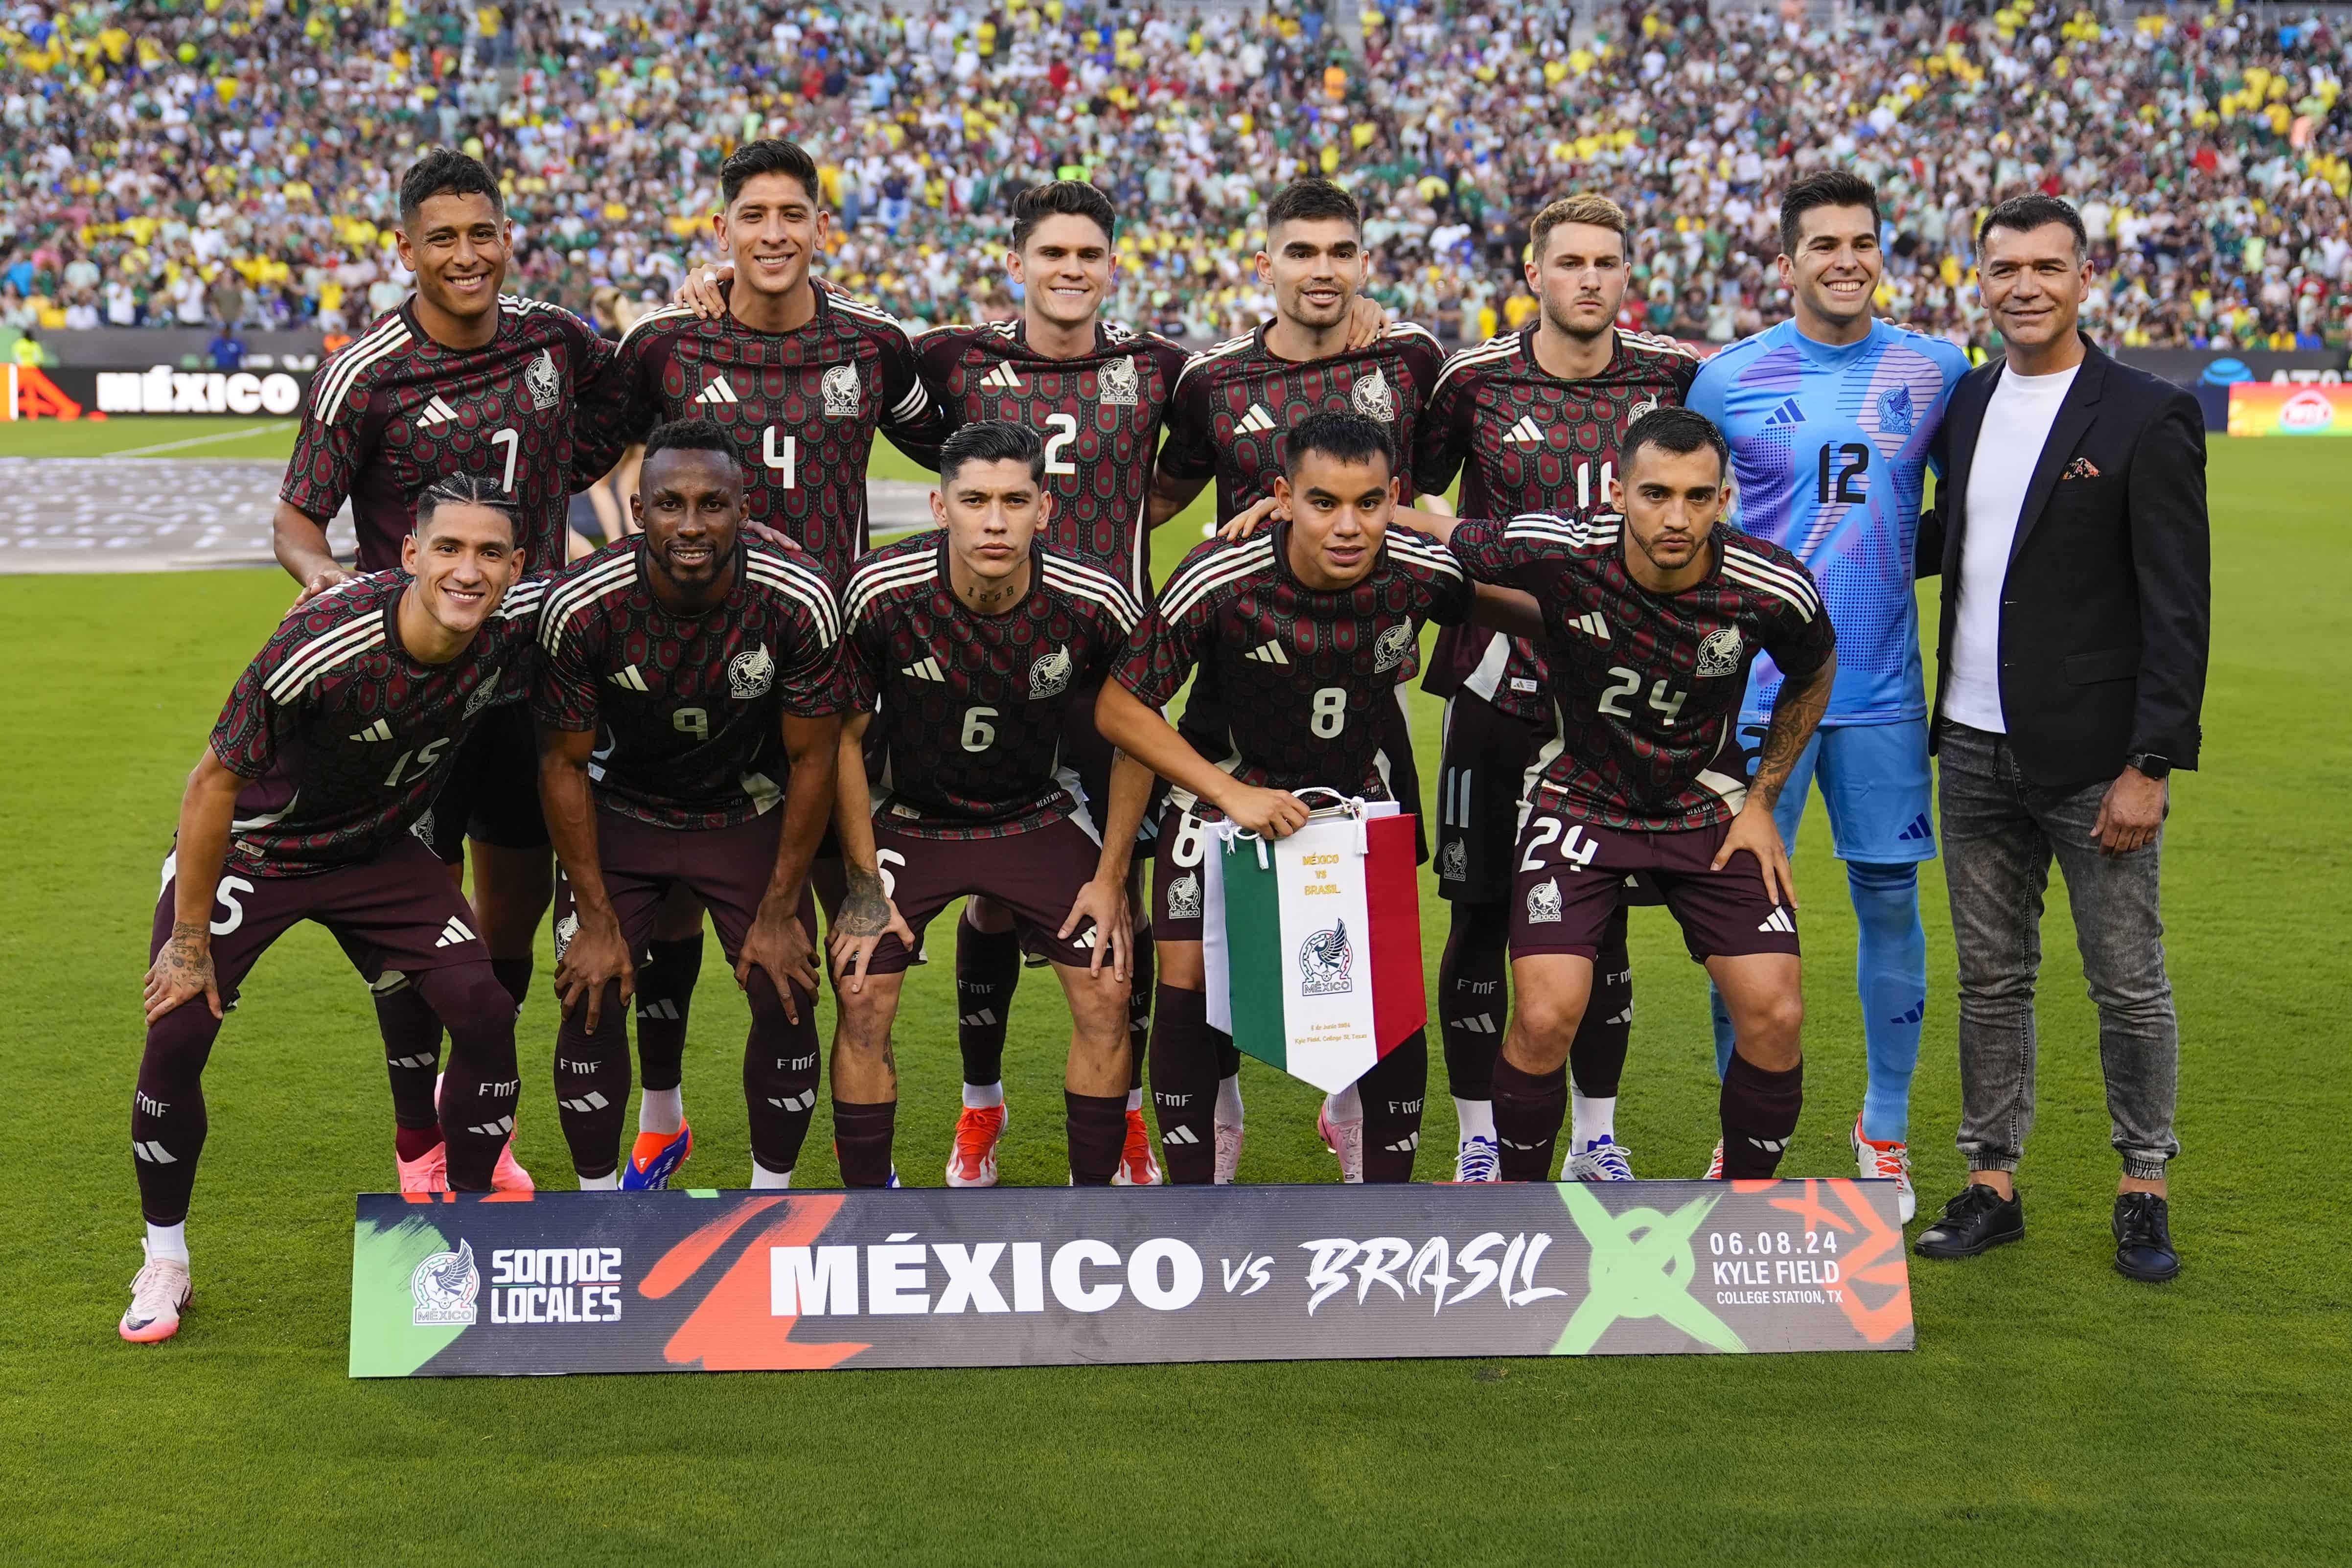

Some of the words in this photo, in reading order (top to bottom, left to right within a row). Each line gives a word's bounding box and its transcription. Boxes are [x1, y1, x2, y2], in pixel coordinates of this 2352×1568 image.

[97, 365, 300, 414] MÉXICO
[1102, 394, 1136, 403] MÉXICO
[828, 404, 857, 413] MÉXICO
[1881, 423, 1911, 433] MÉXICO
[1044, 413, 1077, 474] 2
[492, 428, 519, 492] 7
[763, 425, 795, 489] 4
[1819, 443, 1869, 504] 12
[1699, 667, 1735, 675] MÉXICO
[734, 685, 770, 697] MÉXICO
[1031, 685, 1065, 697] MÉXICO
[1598, 667, 1688, 725] 24
[1311, 688, 1347, 739] 8
[673, 708, 709, 740] 9
[961, 707, 999, 752] 6
[384, 737, 450, 786] 15
[1036, 791, 1062, 808] HEAT.RDY
[1445, 766, 1472, 828] 11
[1172, 811, 1205, 868] 8
[1519, 817, 1599, 872] 24
[1303, 852, 1339, 866] MÉXICO
[1304, 883, 1341, 895] BRASIL
[1170, 909, 1199, 917] MÉXICO
[1531, 913, 1559, 922] MÉXICO
[959, 979, 997, 994] FMF
[1304, 981, 1350, 994] MÉXICO
[1456, 978, 1498, 995] FMF
[560, 1057, 602, 1074] FMF
[777, 1052, 817, 1070] FMF
[479, 1079, 519, 1097] FMF
[137, 1090, 170, 1118] FMF
[1155, 1092, 1193, 1107] FMF
[1388, 1098, 1423, 1115] FMF
[1710, 1231, 1837, 1255] 06.08.24
[770, 1233, 1204, 1316] MÉXICO
[1297, 1232, 1568, 1317] BRASIL
[1713, 1261, 1770, 1285] KYLE
[1776, 1260, 1840, 1284] FIELD
[490, 1286, 622, 1324] LOCALES
[1717, 1291, 1770, 1304] COLLEGE
[1773, 1290, 1825, 1305] STATION,
[1826, 1290, 1843, 1303] TX
[417, 1308, 472, 1321] MÉXICO
